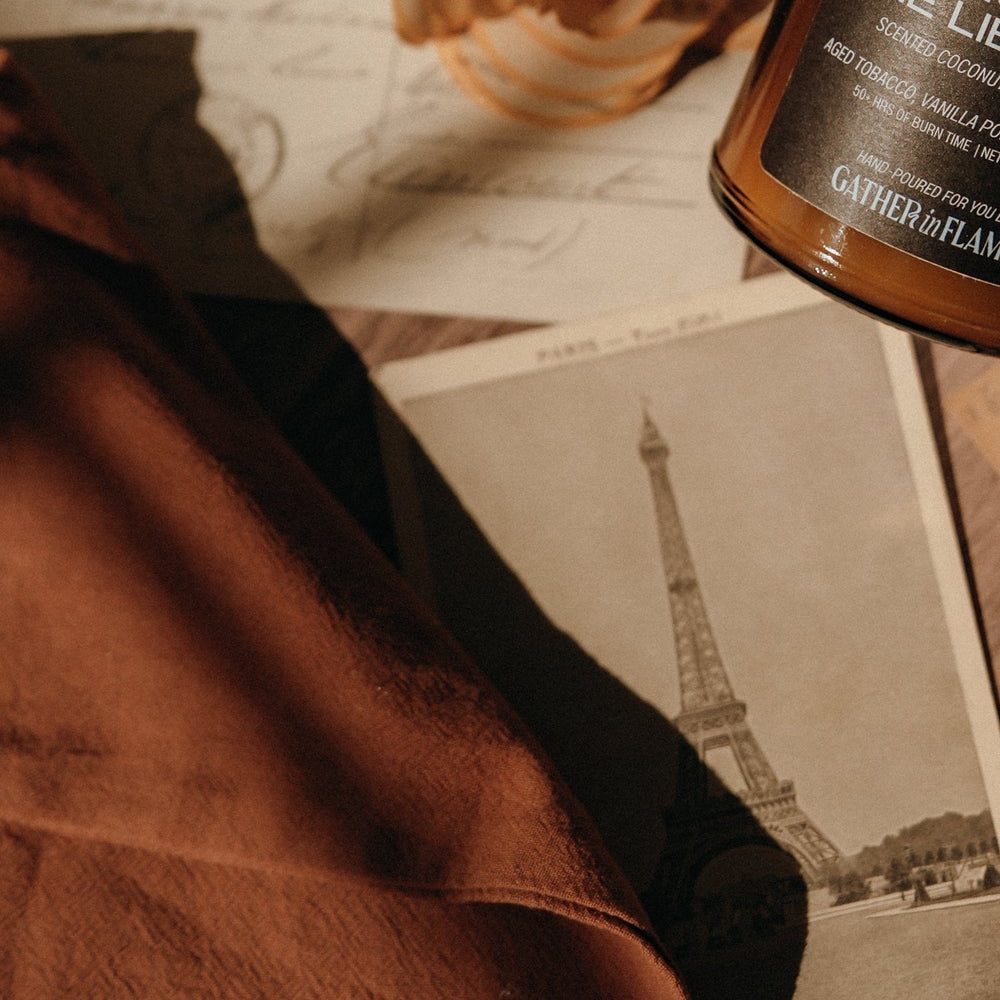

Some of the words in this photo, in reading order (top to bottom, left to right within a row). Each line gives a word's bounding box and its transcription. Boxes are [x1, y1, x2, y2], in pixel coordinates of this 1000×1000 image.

[876, 17, 937, 57] SCENTED
[823, 37, 856, 65] AGED
[853, 56, 917, 104] TOBACCO,
[921, 92, 978, 130] VANILLA
[852, 84, 872, 101] 50+
[872, 95, 896, 116] HRS
[895, 108, 913, 123] OF
[911, 116, 945, 140] BURN
[945, 130, 973, 152] TIME
[831, 164, 922, 230] GATHER
[918, 208, 942, 238] in
[856, 150, 942, 198] HAND-POURED
[942, 189, 971, 209] FOR
[969, 200, 996, 219] YOU
